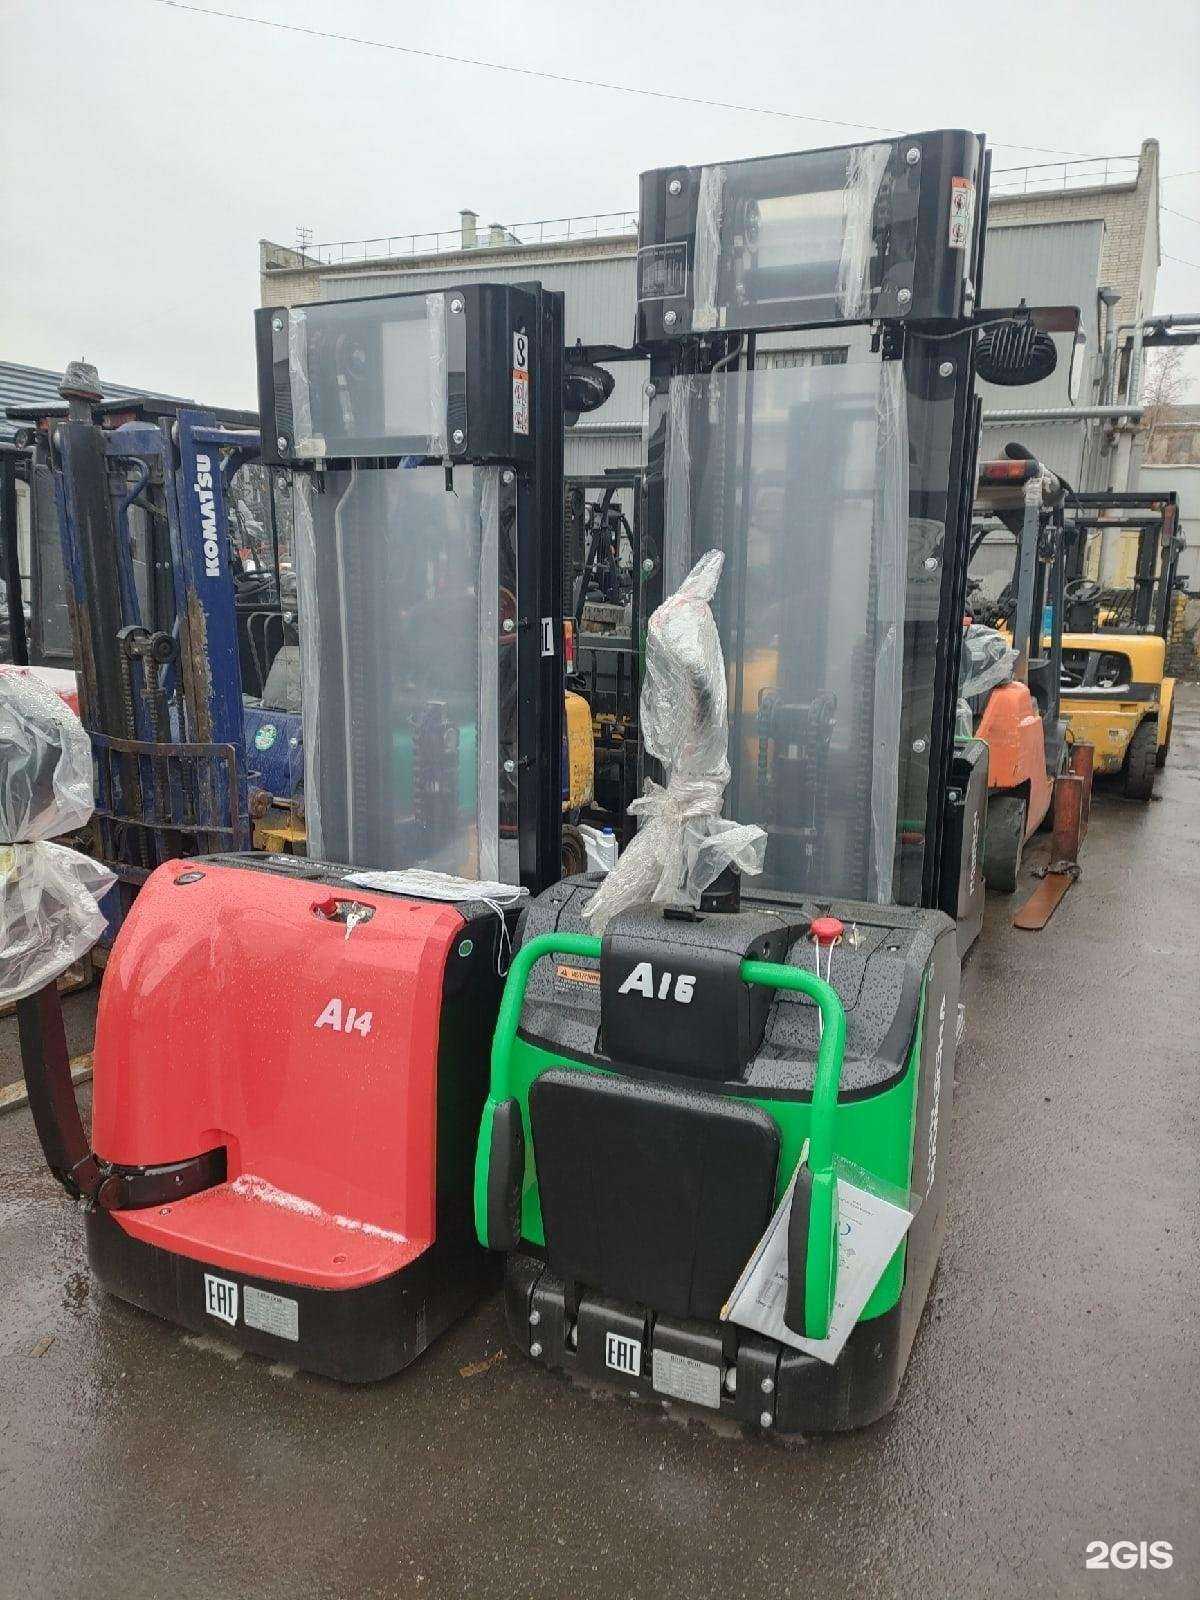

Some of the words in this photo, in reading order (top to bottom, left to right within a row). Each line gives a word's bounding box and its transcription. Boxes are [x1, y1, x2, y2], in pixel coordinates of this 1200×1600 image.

[194, 454, 220, 577] KOMATSU
[618, 962, 696, 1004] A16
[314, 998, 373, 1037] A14
